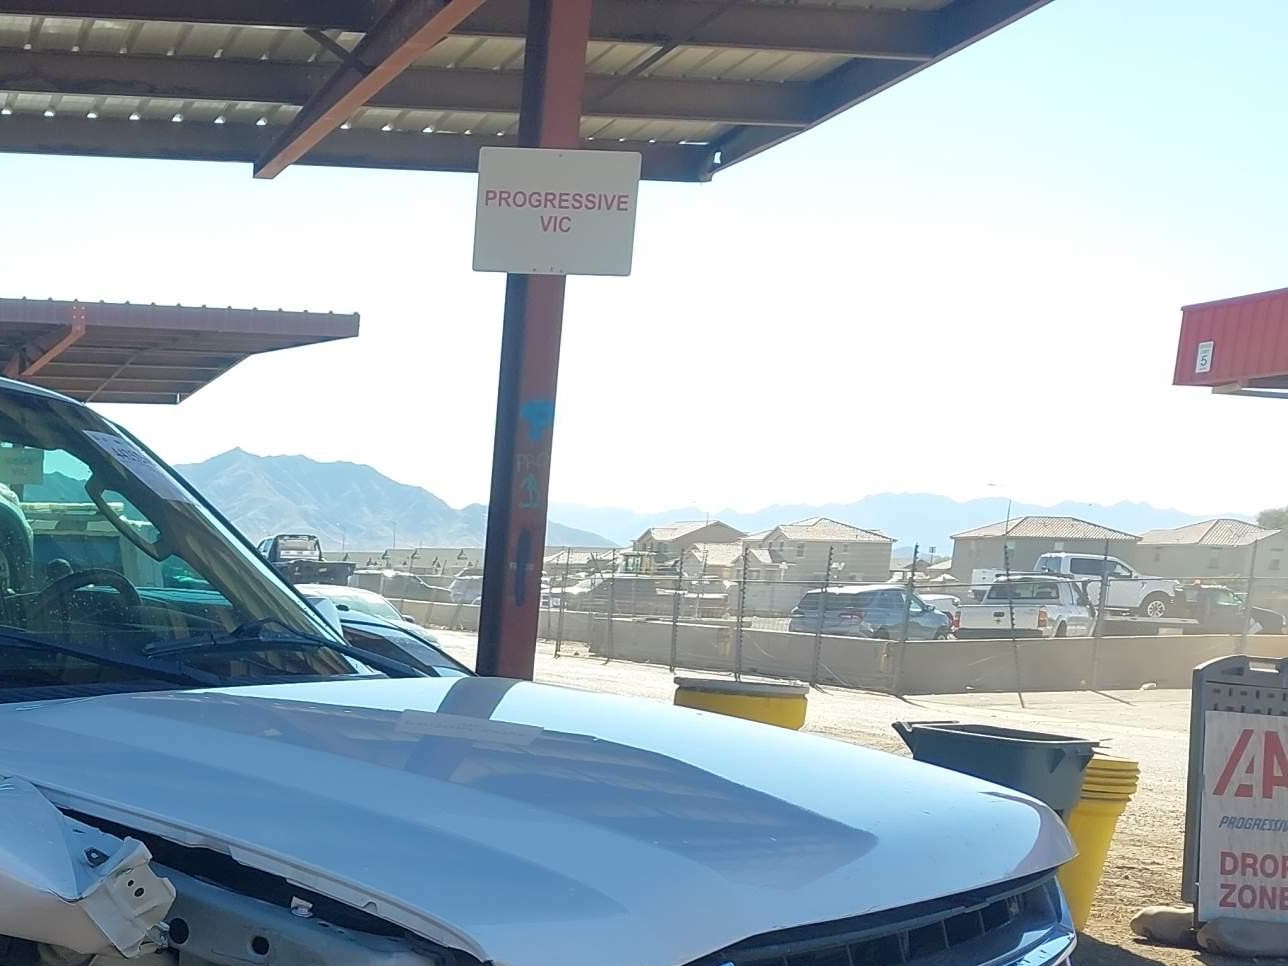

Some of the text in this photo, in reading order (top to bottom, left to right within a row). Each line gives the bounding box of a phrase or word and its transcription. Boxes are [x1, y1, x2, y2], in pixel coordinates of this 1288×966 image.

[485, 190, 629, 212] PROGRESSIVE
[540, 215, 572, 232] VIC
[1200, 355, 1208, 366] 5
